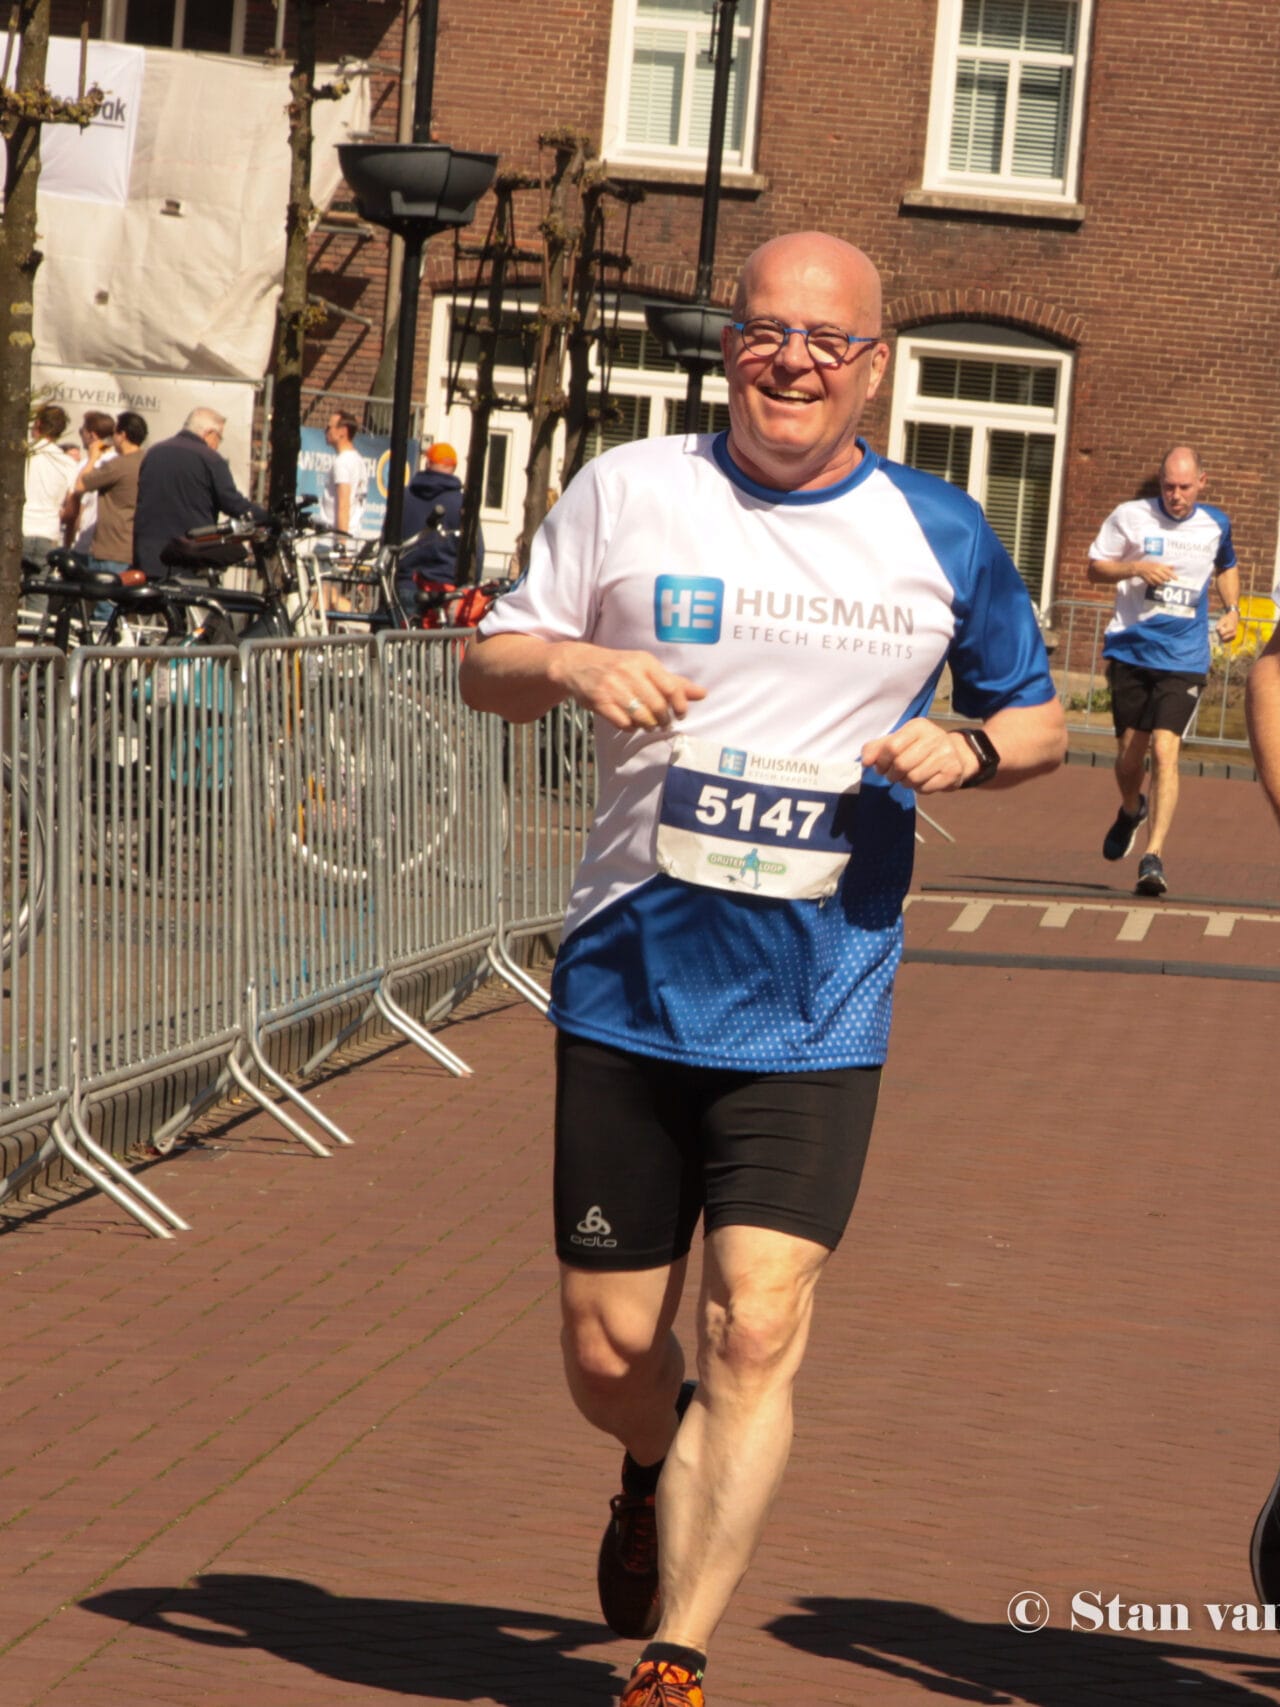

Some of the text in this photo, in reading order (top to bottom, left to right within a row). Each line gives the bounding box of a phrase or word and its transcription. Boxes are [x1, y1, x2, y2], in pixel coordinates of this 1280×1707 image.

[735, 587, 914, 636] HUISMAN
[733, 625, 913, 660] ETECH EXPERTS
[750, 755, 820, 775] HUISMAN
[695, 784, 826, 840] 5147
